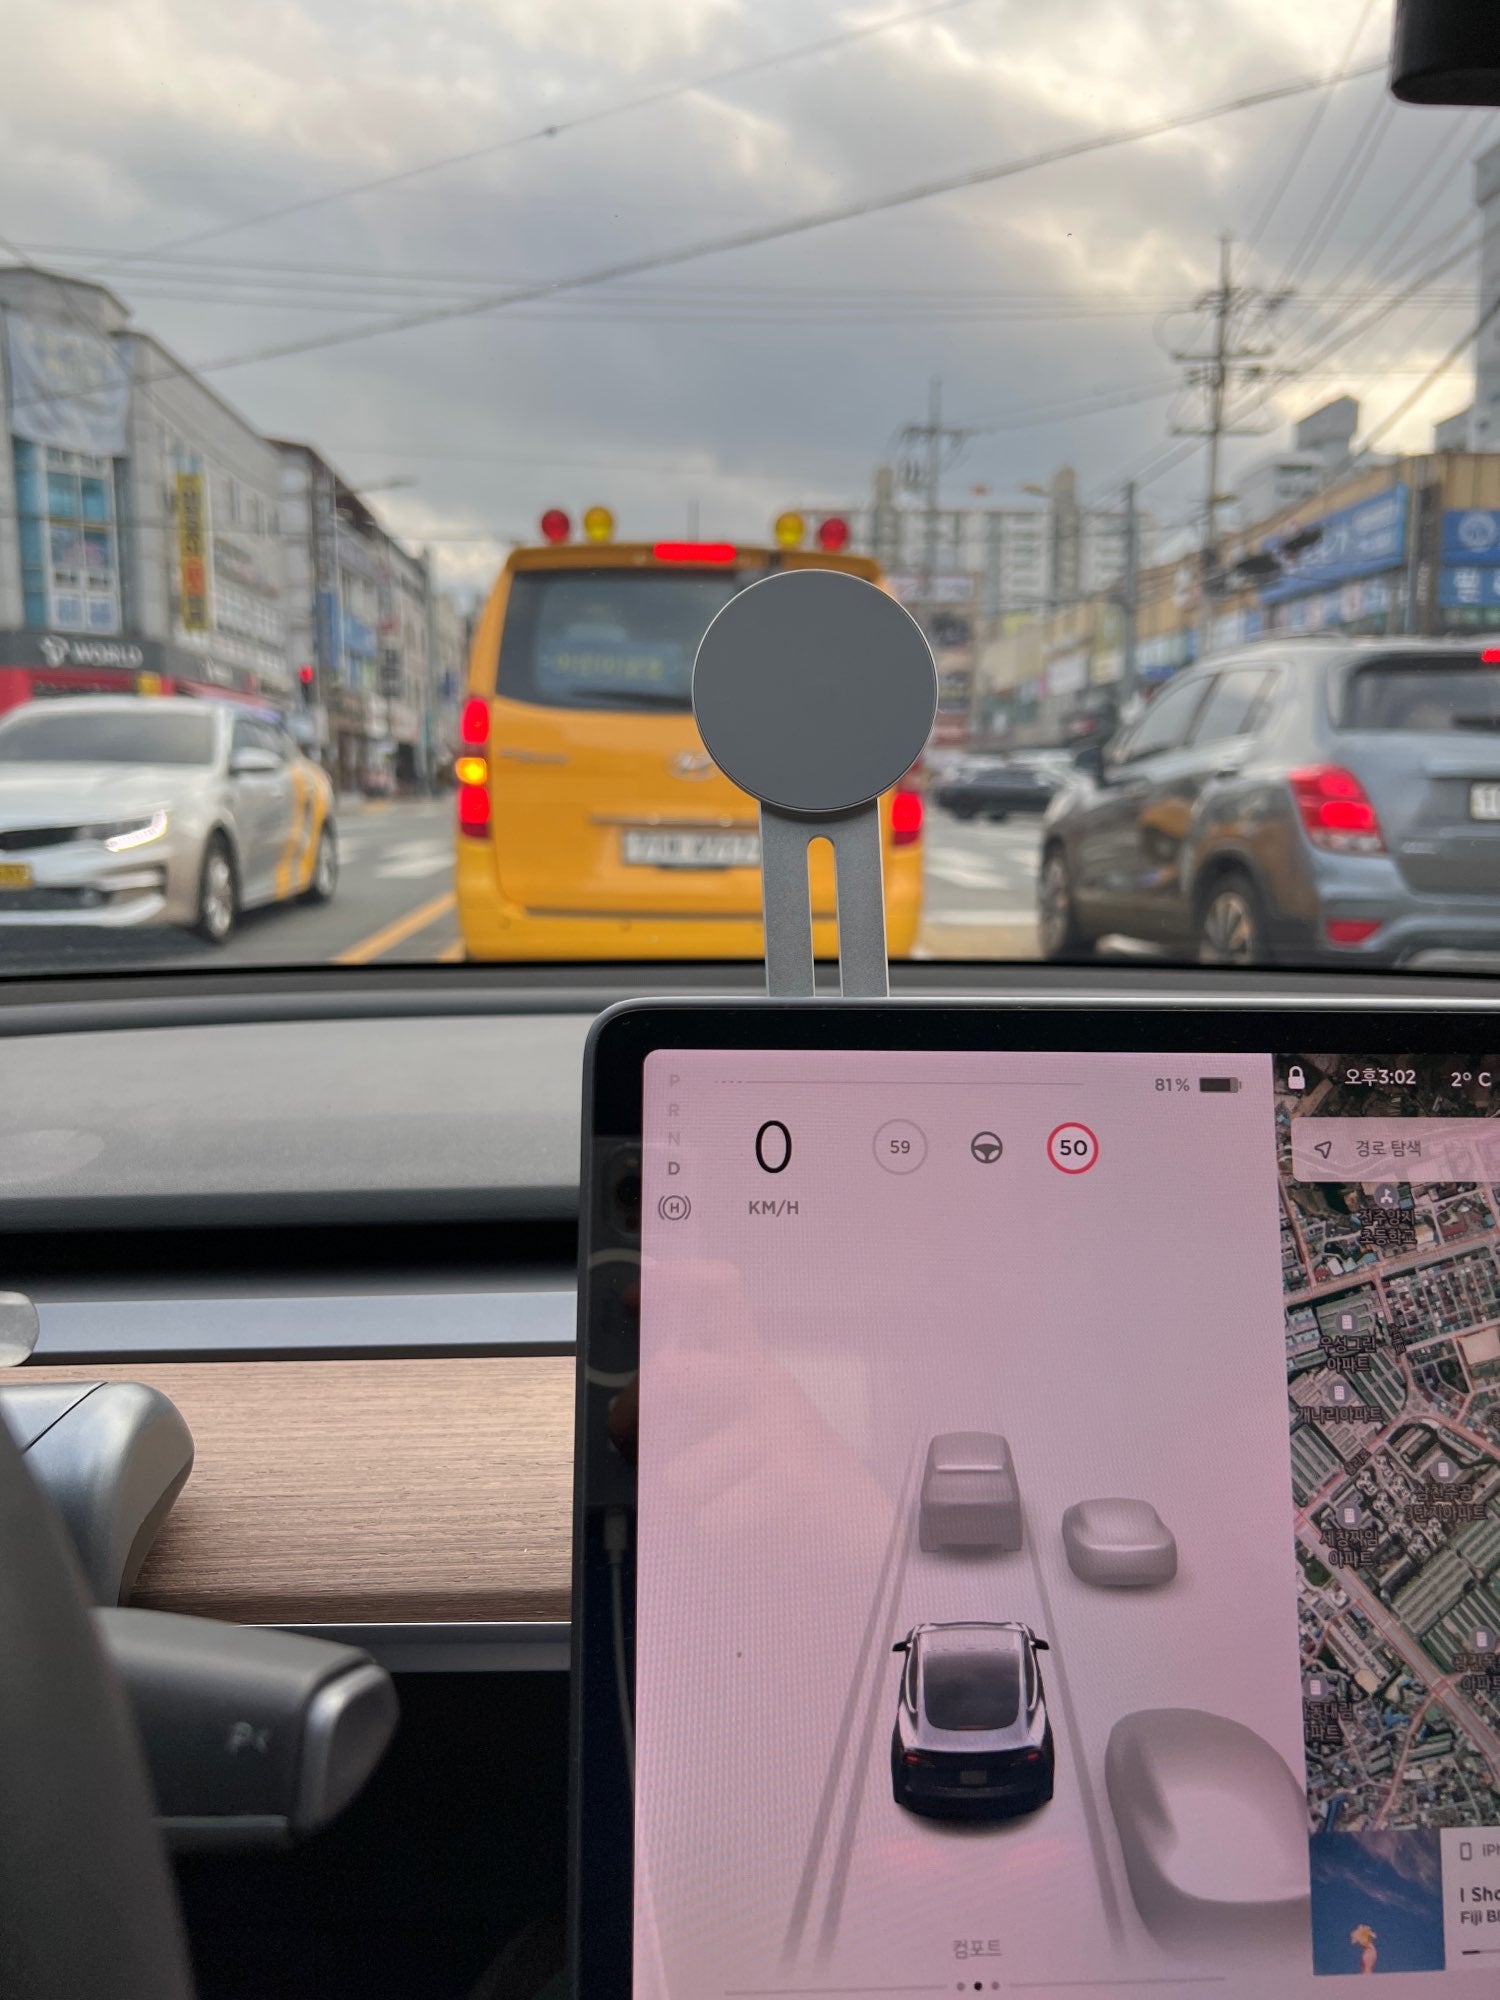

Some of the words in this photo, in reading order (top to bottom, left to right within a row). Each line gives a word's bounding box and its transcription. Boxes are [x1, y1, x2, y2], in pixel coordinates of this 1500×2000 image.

[669, 1074, 680, 1088] P
[1154, 1077, 1191, 1093] 81%
[668, 1103, 680, 1117] R
[668, 1132, 680, 1146] N
[755, 1119, 792, 1174] 0
[889, 1139, 911, 1155] 59
[1059, 1139, 1088, 1156] 50
[1356, 1139, 1387, 1158] 경로
[1391, 1139, 1422, 1158] 탐색
[668, 1161, 681, 1176] D
[749, 1200, 799, 1217] KM/H
[1360, 1228, 1417, 1246] 초등학교
[1320, 1335, 1377, 1353] 우성그린
[1327, 1356, 1371, 1373] 아파트
[1297, 1405, 1383, 1424] 개나리아파트
[1414, 1483, 1473, 1503] 삼천주공
[1405, 1504, 1488, 1522] 3단지아파트
[1328, 1550, 1373, 1568] 아파트
[1304, 1722, 1341, 1741] 파트
[953, 1939, 1003, 1960] 컴포트
